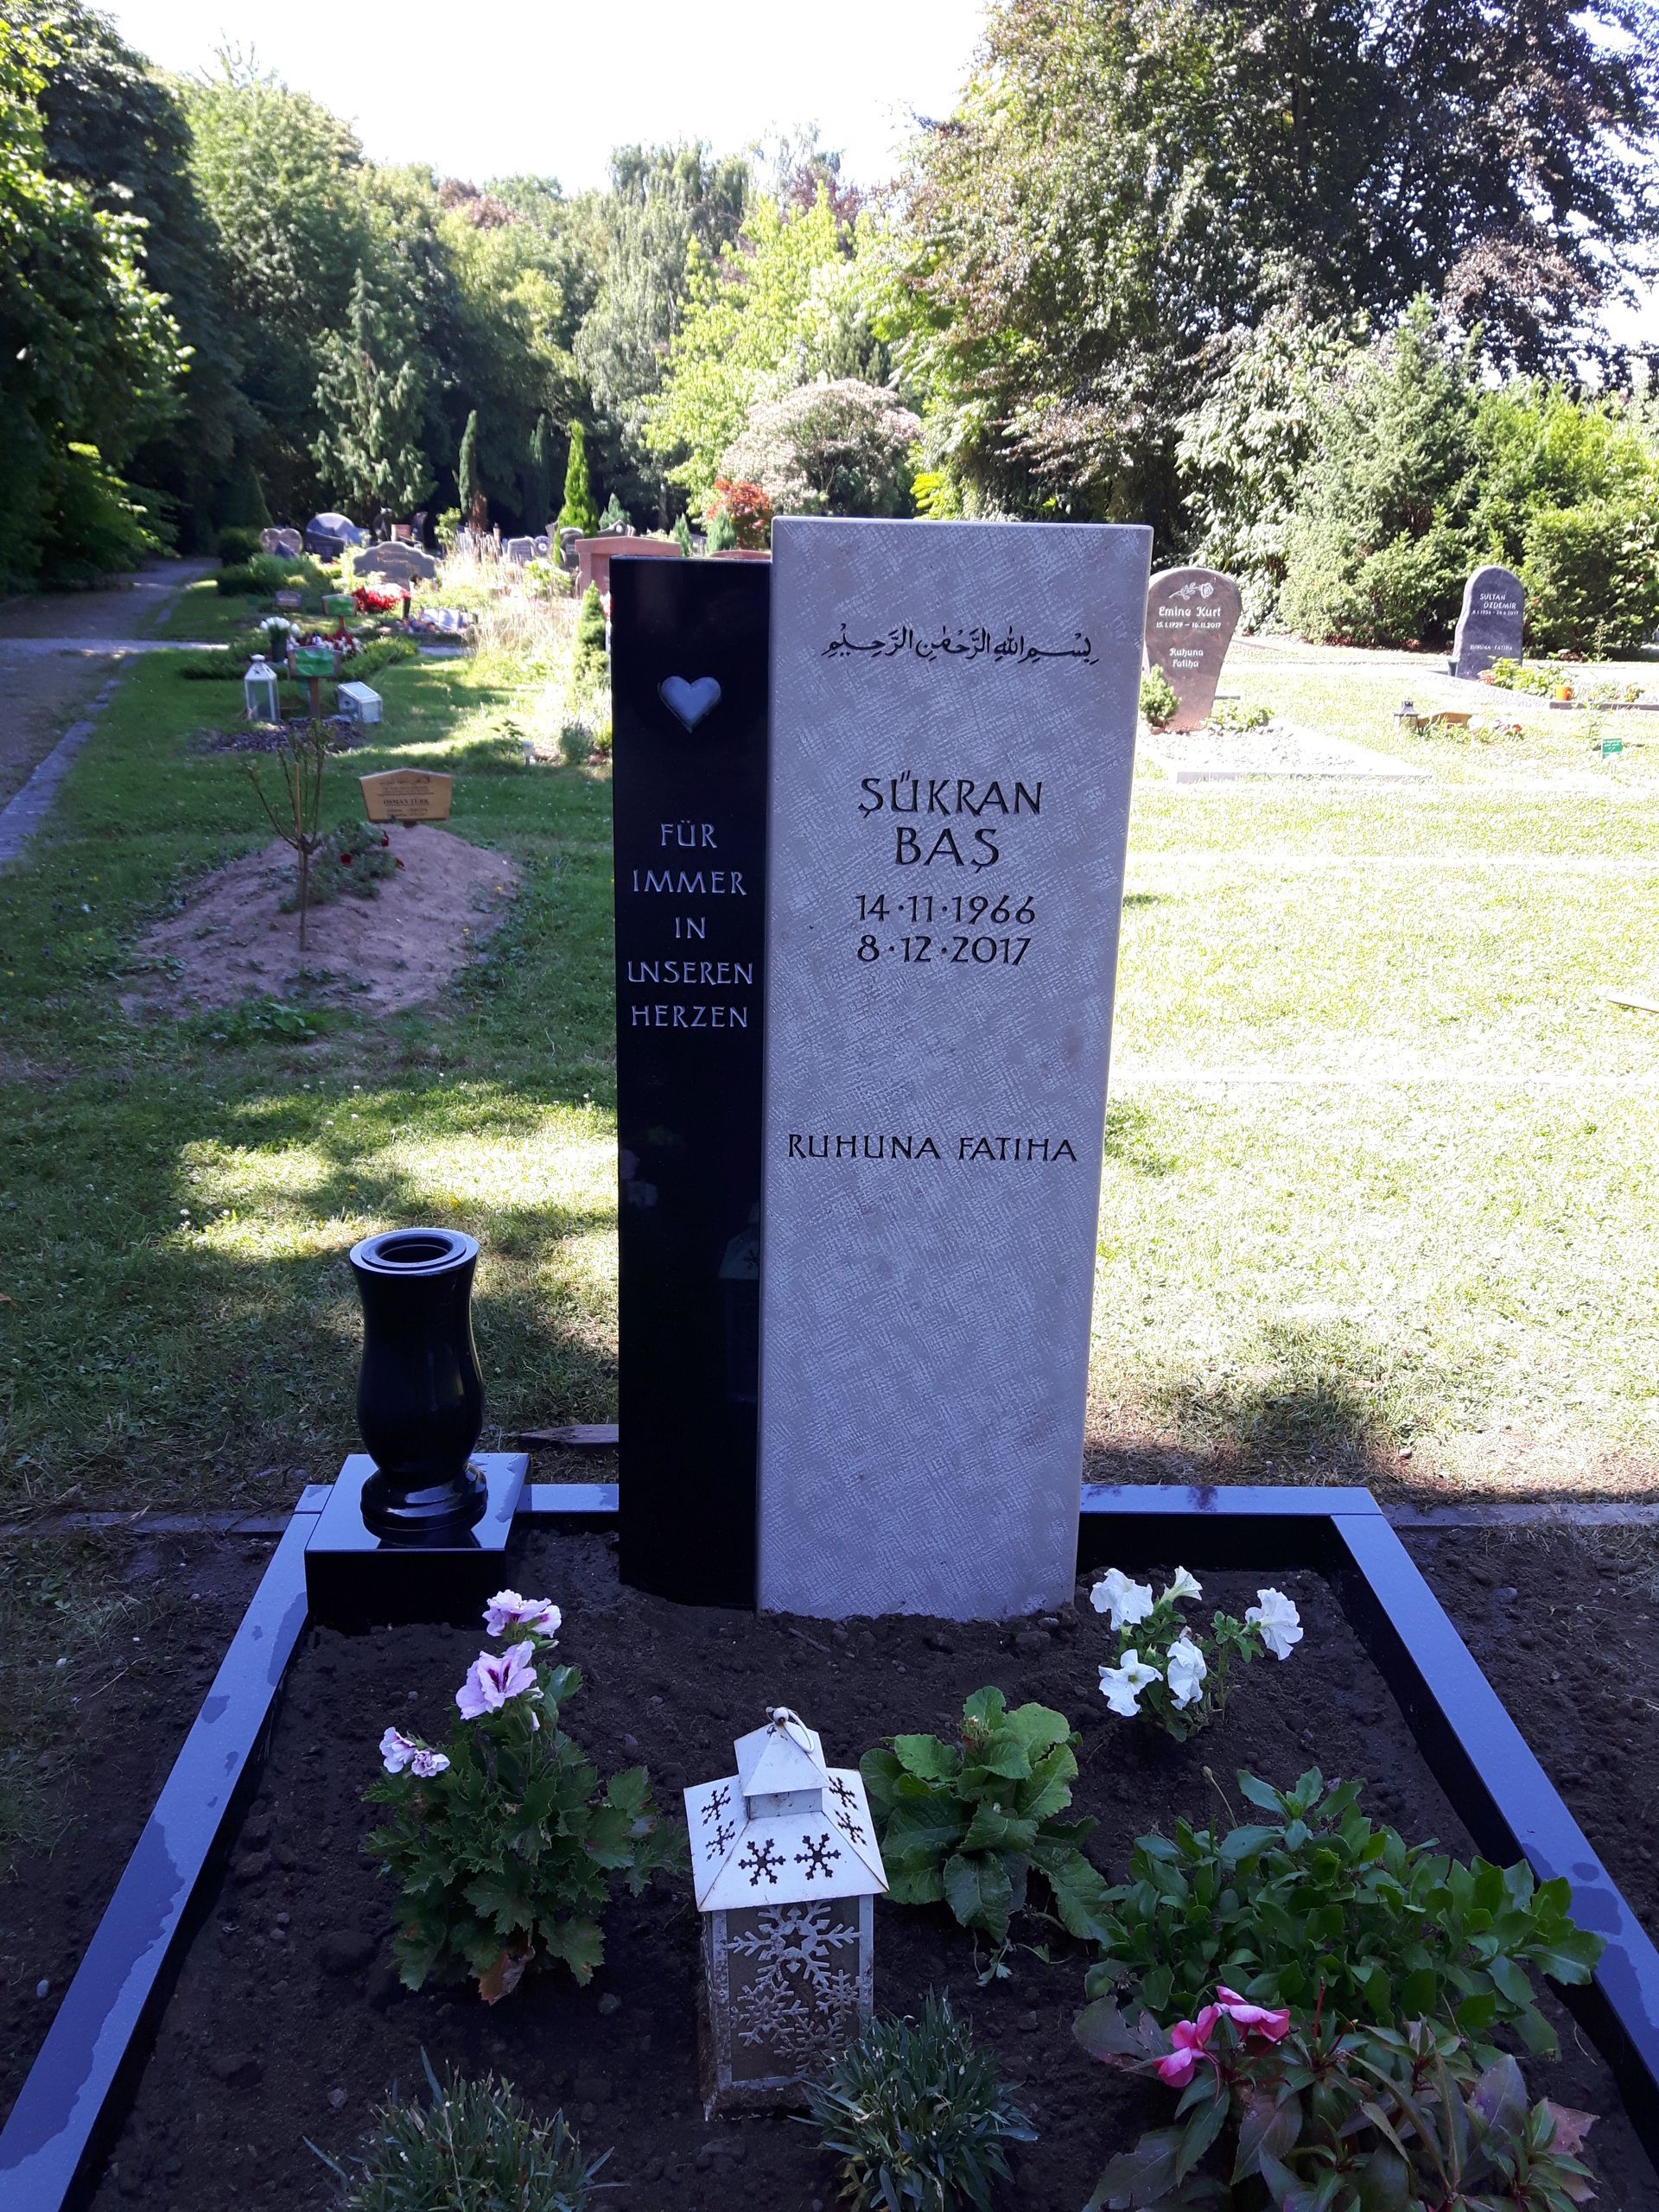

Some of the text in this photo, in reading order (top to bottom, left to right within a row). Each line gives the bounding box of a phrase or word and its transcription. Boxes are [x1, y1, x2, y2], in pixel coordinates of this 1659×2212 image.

[1159, 606, 1222, 617] Emine Kurt
[1169, 647, 1204, 658] Ruhuna
[1172, 658, 1199, 668] Fatiha
[857, 770, 1042, 817] ŞÜKRAN
[660, 820, 717, 849] FÜR
[893, 826, 1000, 874] BAŞ
[632, 869, 747, 895] IMMER
[675, 917, 706, 938] IN
[627, 961, 753, 985] UNSEREN
[632, 1005, 747, 1028] HERZEN
[787, 1134, 1078, 1162] RUHUNA FATIHA
